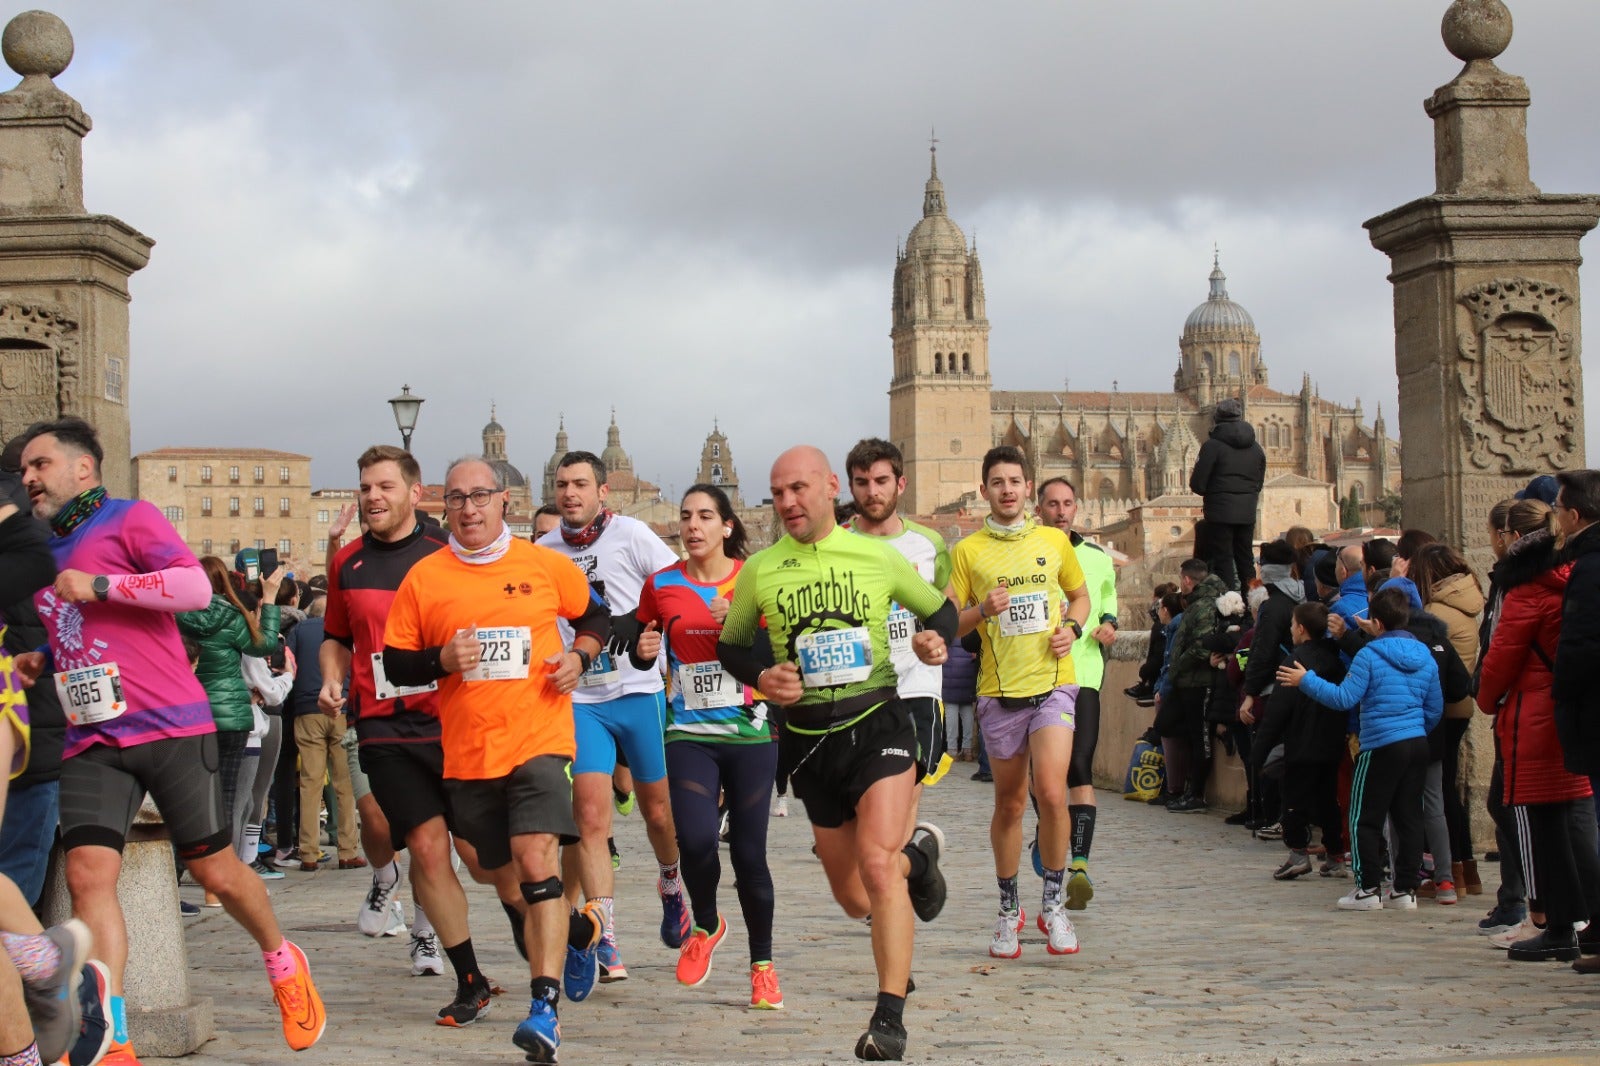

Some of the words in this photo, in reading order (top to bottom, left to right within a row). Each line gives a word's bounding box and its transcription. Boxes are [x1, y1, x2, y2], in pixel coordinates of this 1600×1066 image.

[1031, 573, 1047, 584] GO
[776, 566, 870, 632] Samarbike
[887, 611, 916, 622] ETEL
[1009, 603, 1036, 622] 632
[815, 631, 864, 645] SETEL
[888, 621, 908, 640] 66
[479, 641, 511, 663] 223
[807, 643, 856, 669] 3559
[695, 663, 722, 673] SET
[693, 673, 723, 693] 897
[66, 681, 102, 708] 1365
